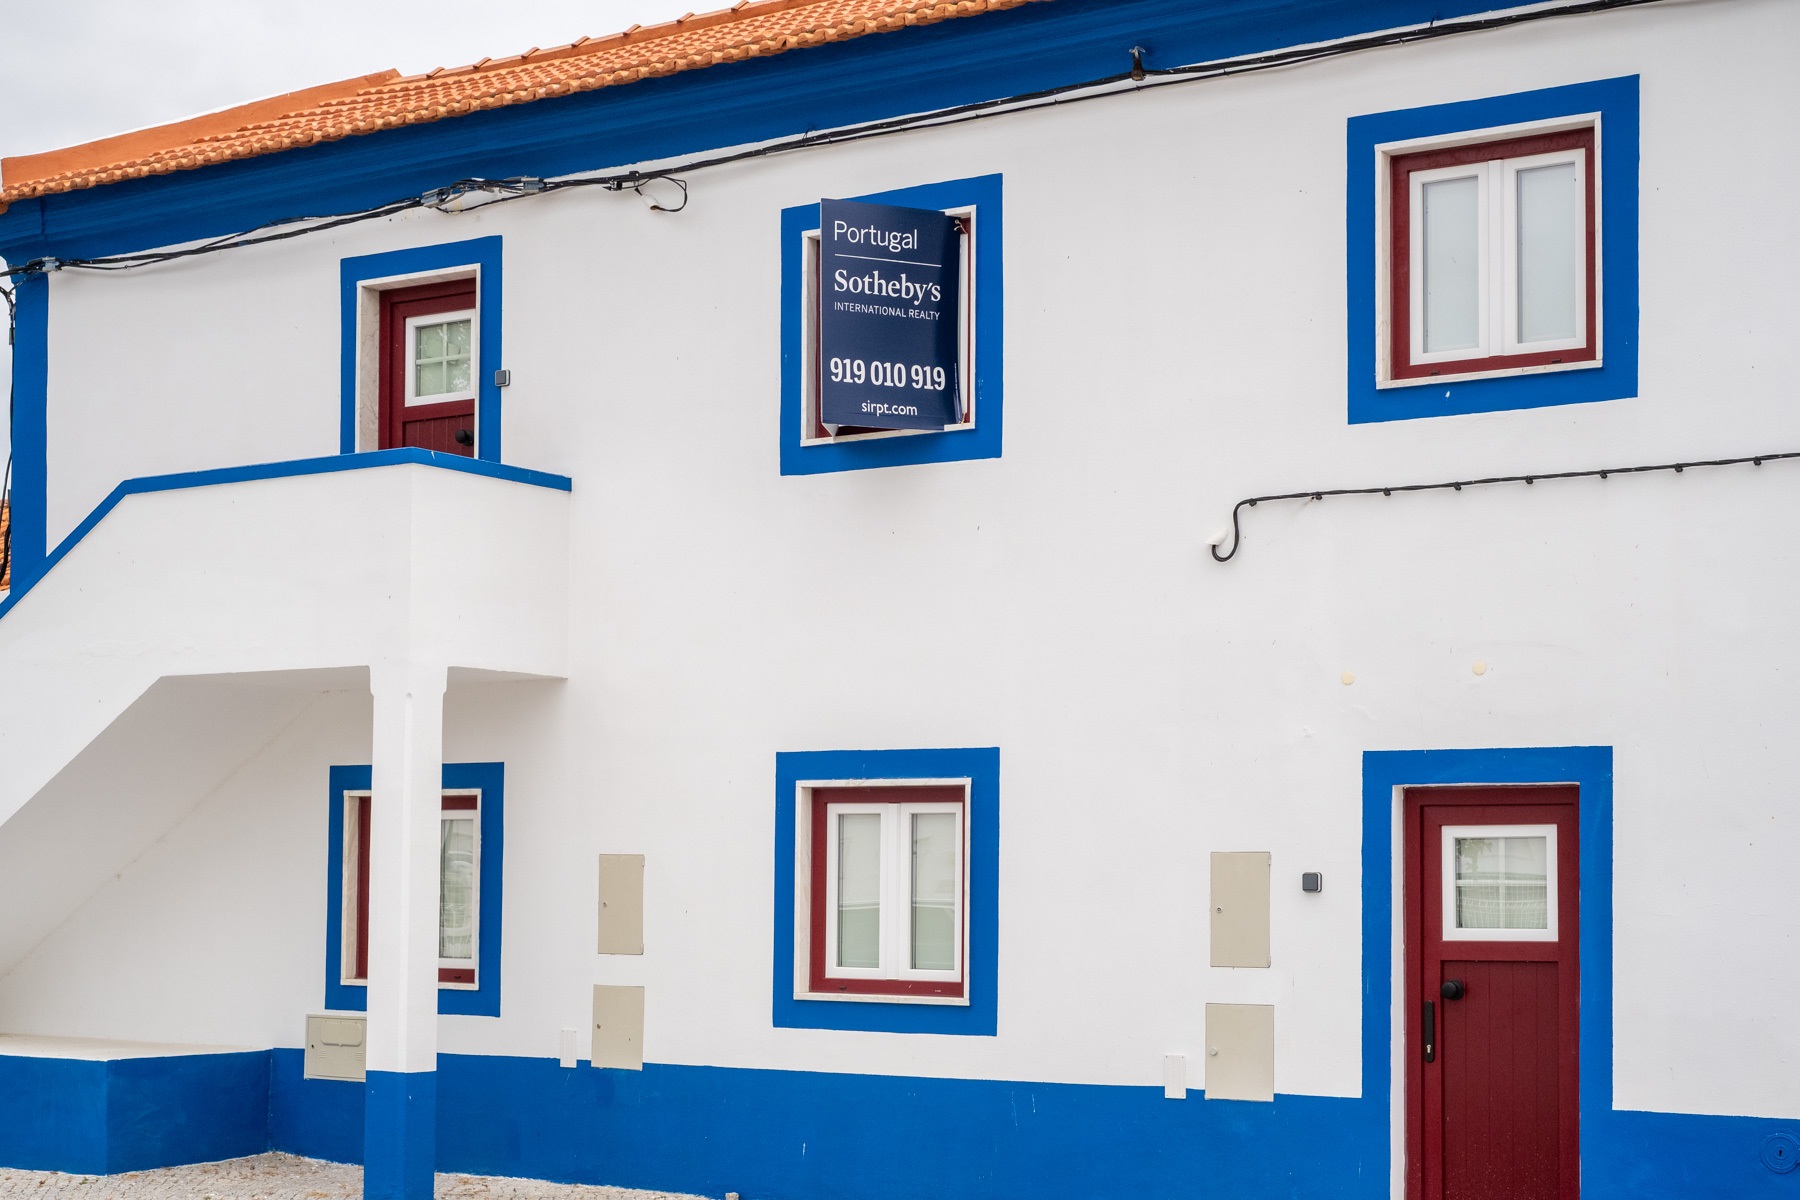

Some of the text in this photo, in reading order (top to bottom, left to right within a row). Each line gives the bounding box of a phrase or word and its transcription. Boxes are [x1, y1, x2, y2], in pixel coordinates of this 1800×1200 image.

[834, 220, 918, 253] Portugal
[834, 268, 941, 305] Sotheby's
[834, 301, 941, 321] INTERNATIONAL REALTY
[830, 357, 946, 391] 919 010 919
[861, 400, 918, 417] sirpt.com
